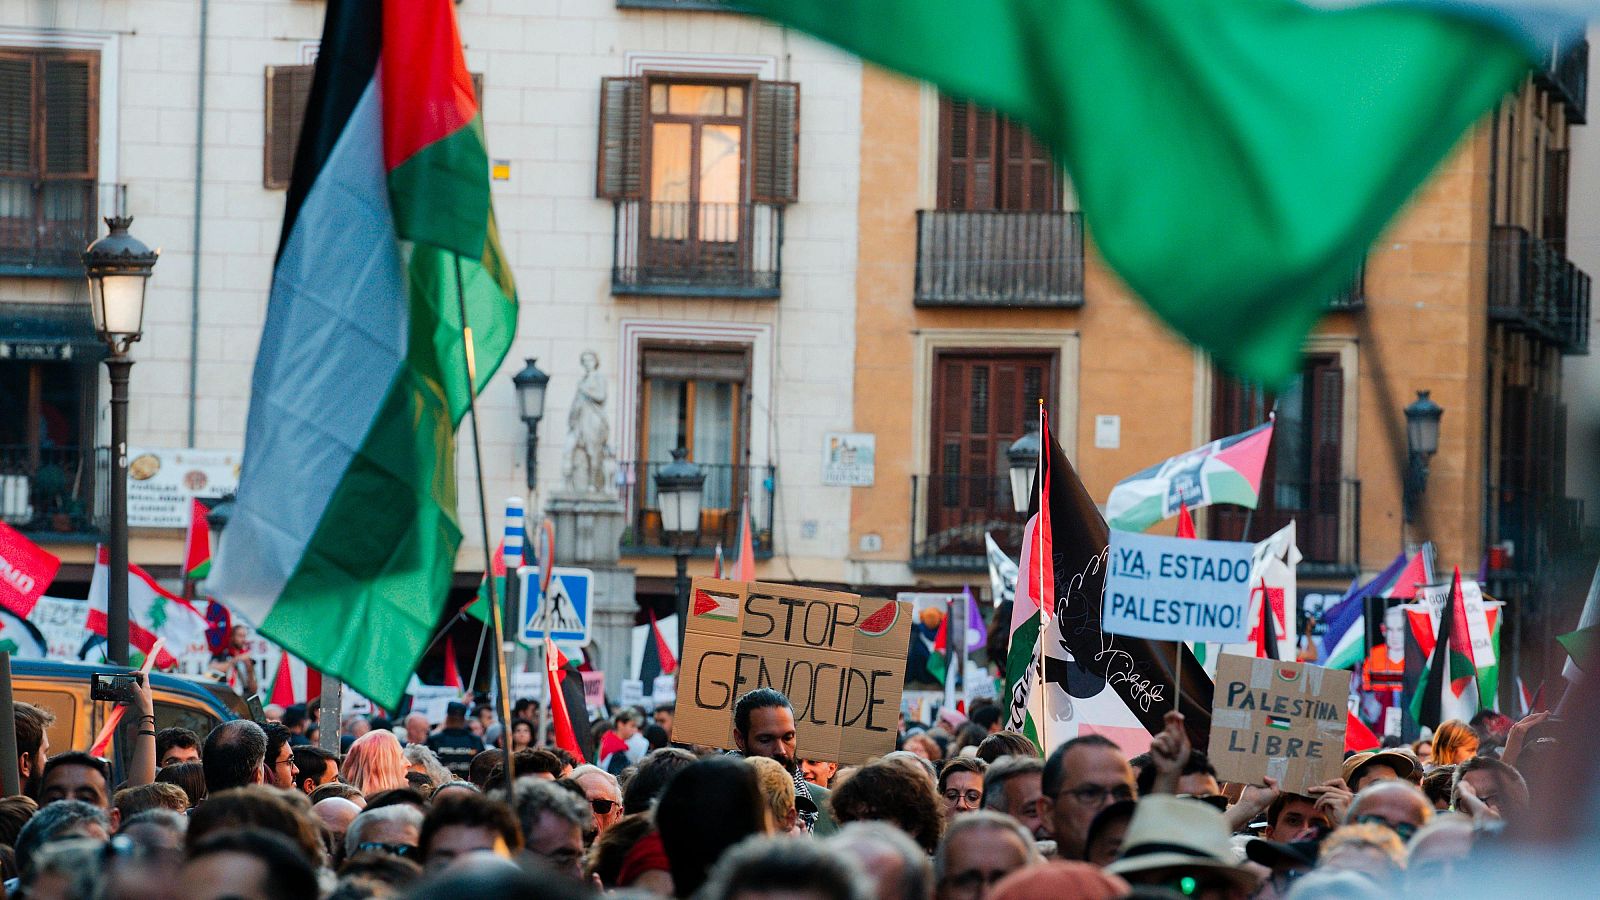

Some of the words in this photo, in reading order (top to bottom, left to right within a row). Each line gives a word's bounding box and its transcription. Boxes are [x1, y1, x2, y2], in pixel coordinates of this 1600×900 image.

[1112, 547, 1150, 579] ¡YA,
[1159, 553, 1250, 583] ESTADO
[742, 593, 860, 648] STOP
[1112, 593, 1242, 629] PALESTINO!
